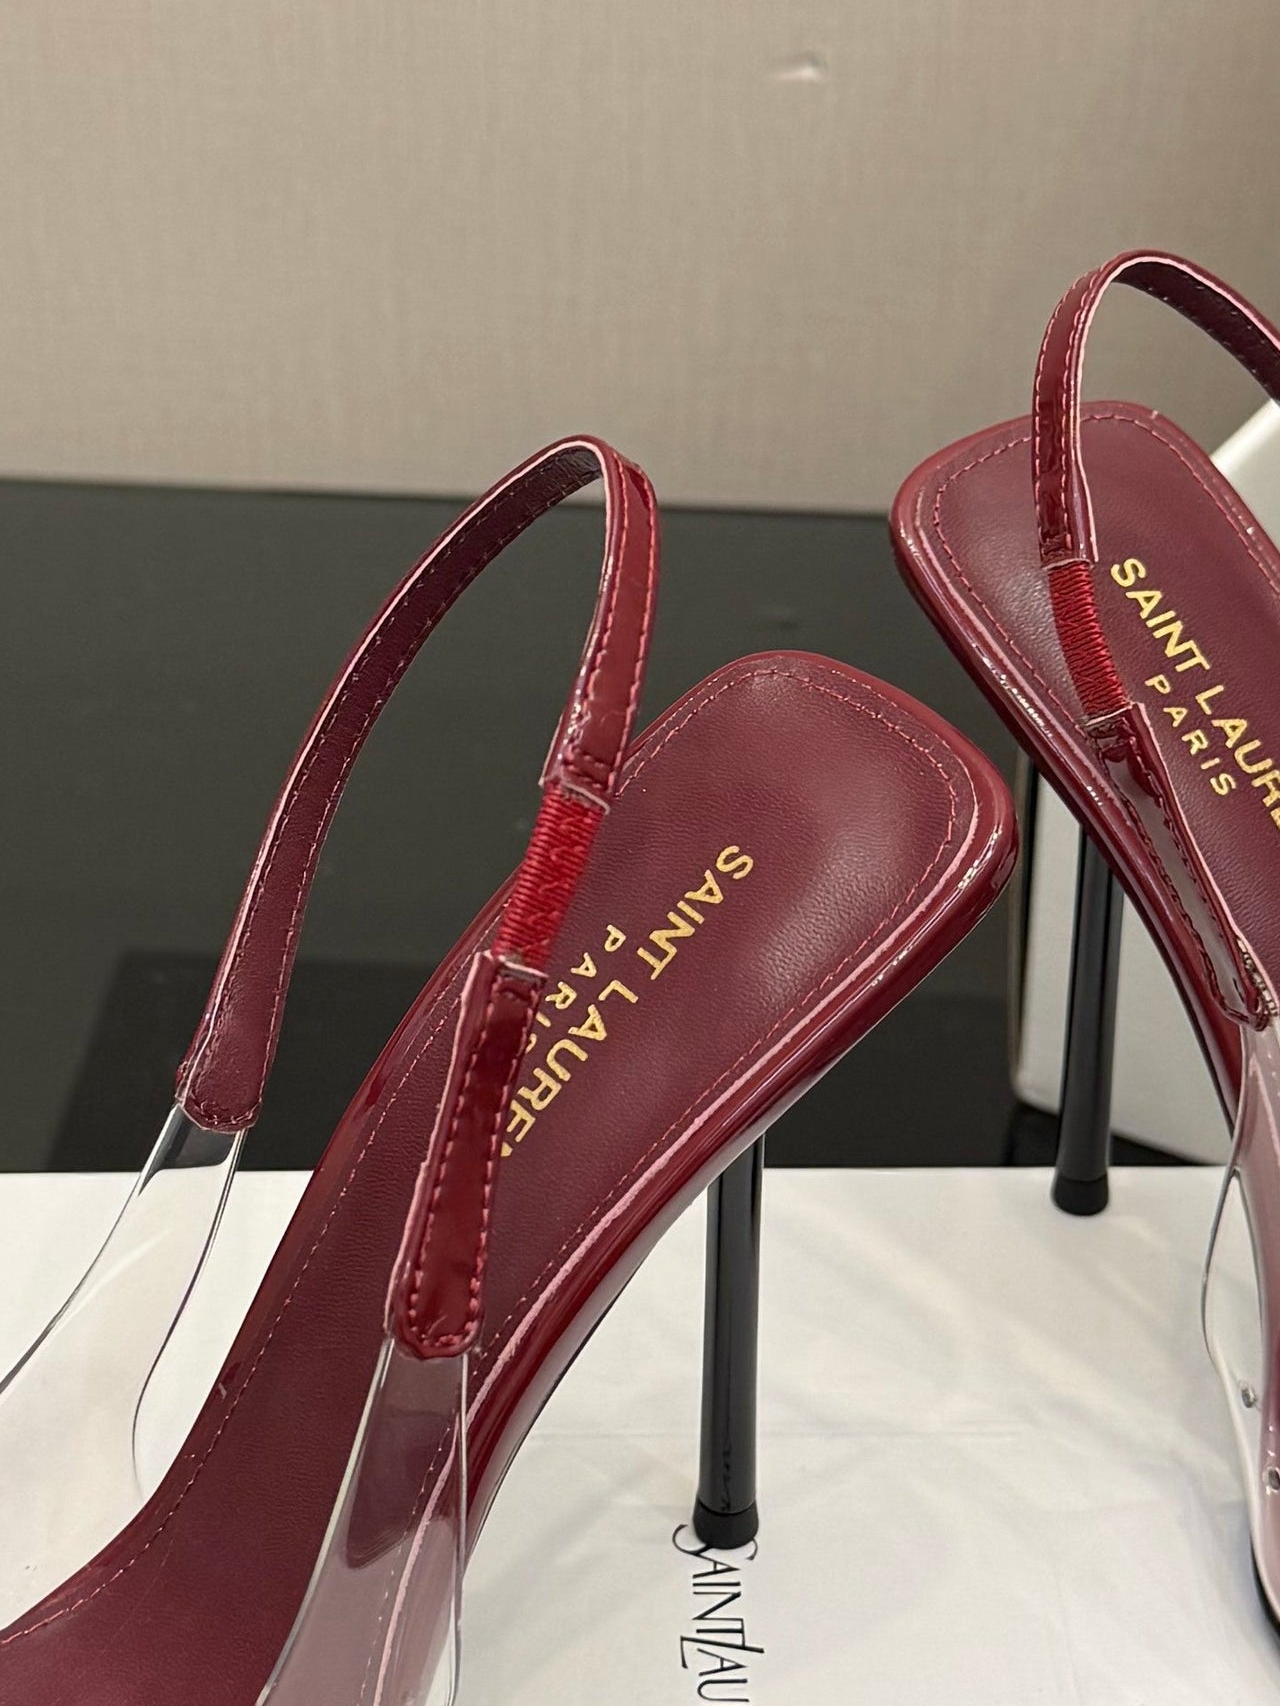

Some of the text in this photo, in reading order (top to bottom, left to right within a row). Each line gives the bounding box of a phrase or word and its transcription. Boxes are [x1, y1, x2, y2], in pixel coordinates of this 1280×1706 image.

[1110, 557, 1211, 673] SAINT
[1144, 673, 1236, 796] PARIS
[500, 845, 754, 1158] SAINT LAURE
